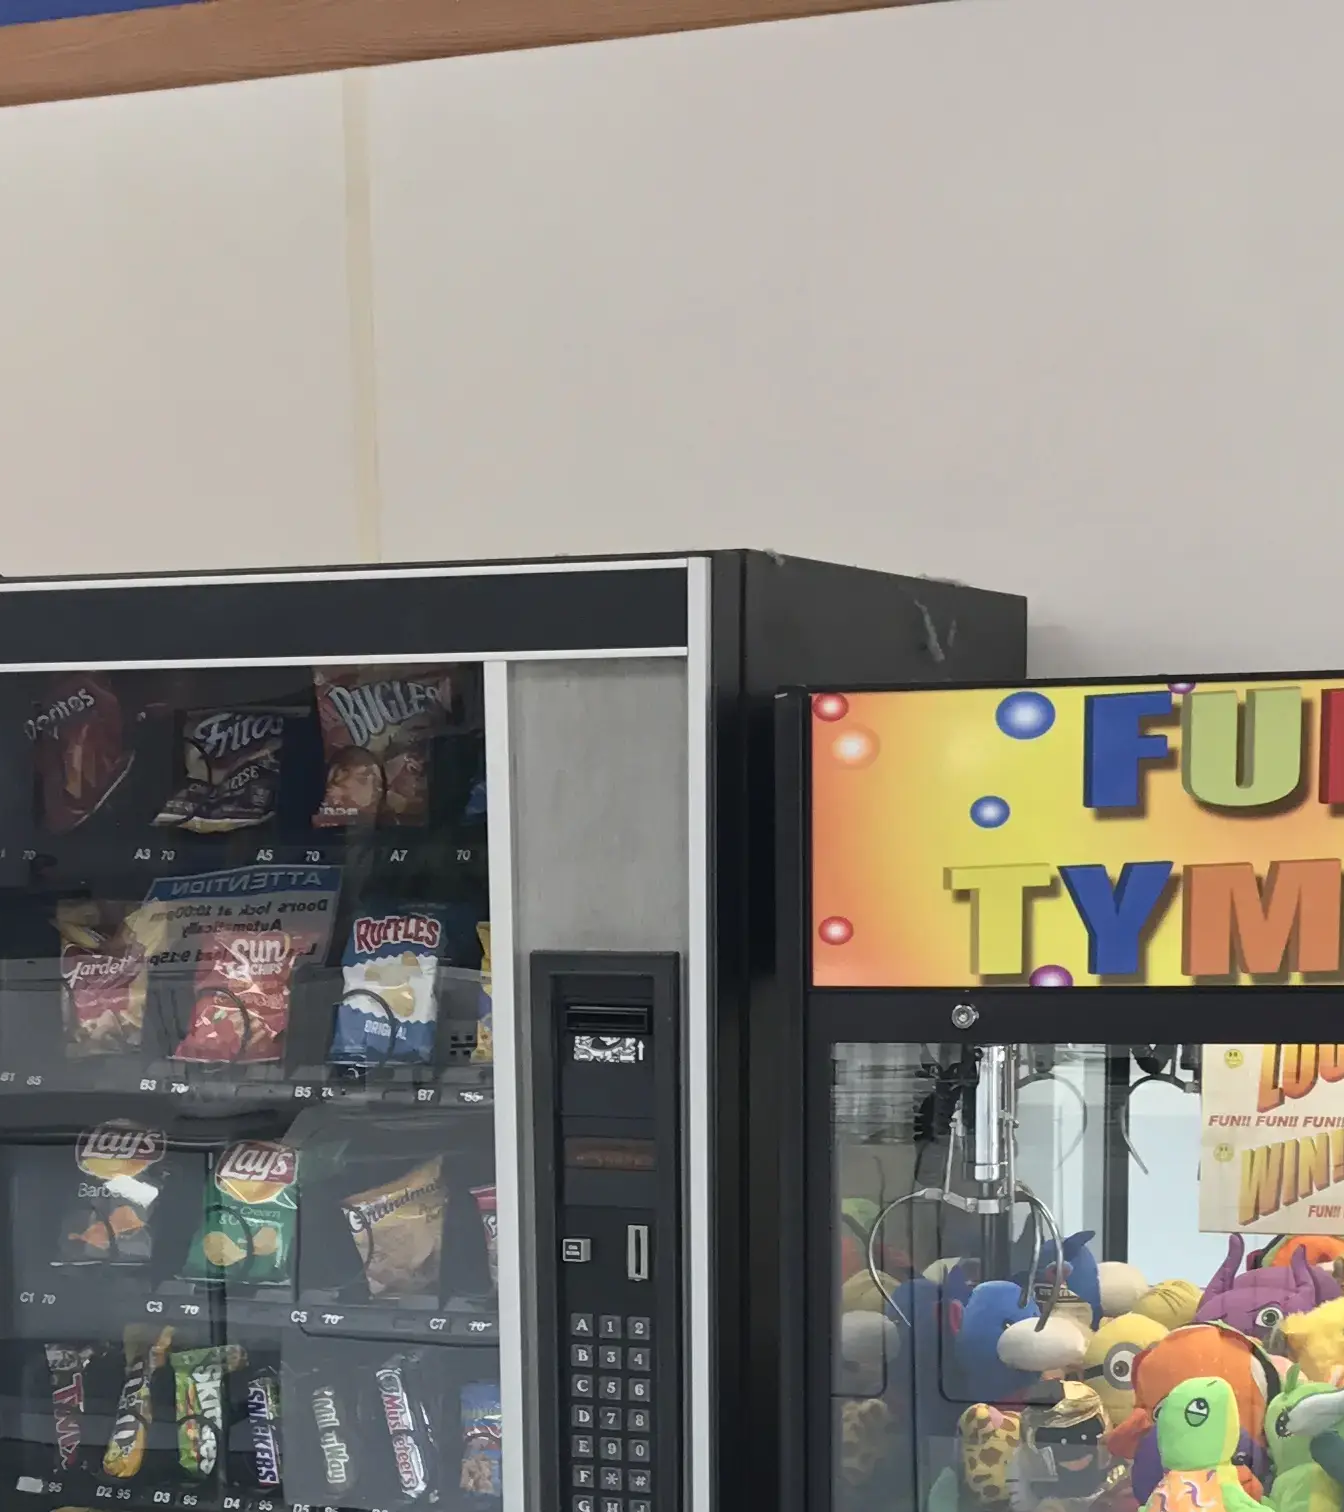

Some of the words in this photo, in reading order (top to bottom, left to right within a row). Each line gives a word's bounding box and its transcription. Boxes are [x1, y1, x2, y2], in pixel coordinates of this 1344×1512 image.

[134, 848, 151, 860] A3
[161, 850, 175, 860] 70
[256, 849, 273, 861] A5
[306, 851, 320, 862] 70
[390, 850, 408, 862] A7
[456, 850, 471, 860] 70
[354, 915, 441, 953] RUFFLES
[364, 1019, 407, 1041] ORIGIAL
[140, 1079, 156, 1090] B3
[294, 1087, 311, 1098] B5
[417, 1089, 434, 1101] B7
[1208, 1115, 1251, 1127] FUN!!
[1255, 1115, 1299, 1127] FUN!!
[81, 1127, 161, 1159] Lay's
[220, 1143, 295, 1180] Lay's
[1308, 1204, 1340, 1218] FUN!!
[146, 1301, 163, 1313] C3
[291, 1311, 307, 1323] C5
[429, 1318, 446, 1330] C7
[576, 1319, 588, 1331] A
[607, 1321, 614, 1333] 1
[634, 1323, 643, 1334] 2
[578, 1350, 588, 1361] B
[606, 1352, 616, 1363] 3
[634, 1353, 643, 1365] 4
[577, 1380, 588, 1392] C
[606, 1382, 616, 1394] 5
[634, 1384, 644, 1396] 6
[578, 1410, 590, 1422] D
[606, 1413, 616, 1425] 7
[635, 1414, 644, 1427] 8
[579, 1440, 589, 1453] E
[607, 1443, 616, 1455] 9
[635, 1445, 644, 1457] 0
[579, 1471, 590, 1483] F
[96, 1485, 113, 1498] D2
[116, 1489, 131, 1500] 95
[153, 1491, 170, 1504] D3
[183, 1495, 198, 1506] 95
[223, 1497, 240, 1509] D4
[258, 1500, 273, 1511] 95
[578, 1500, 590, 1512] G
